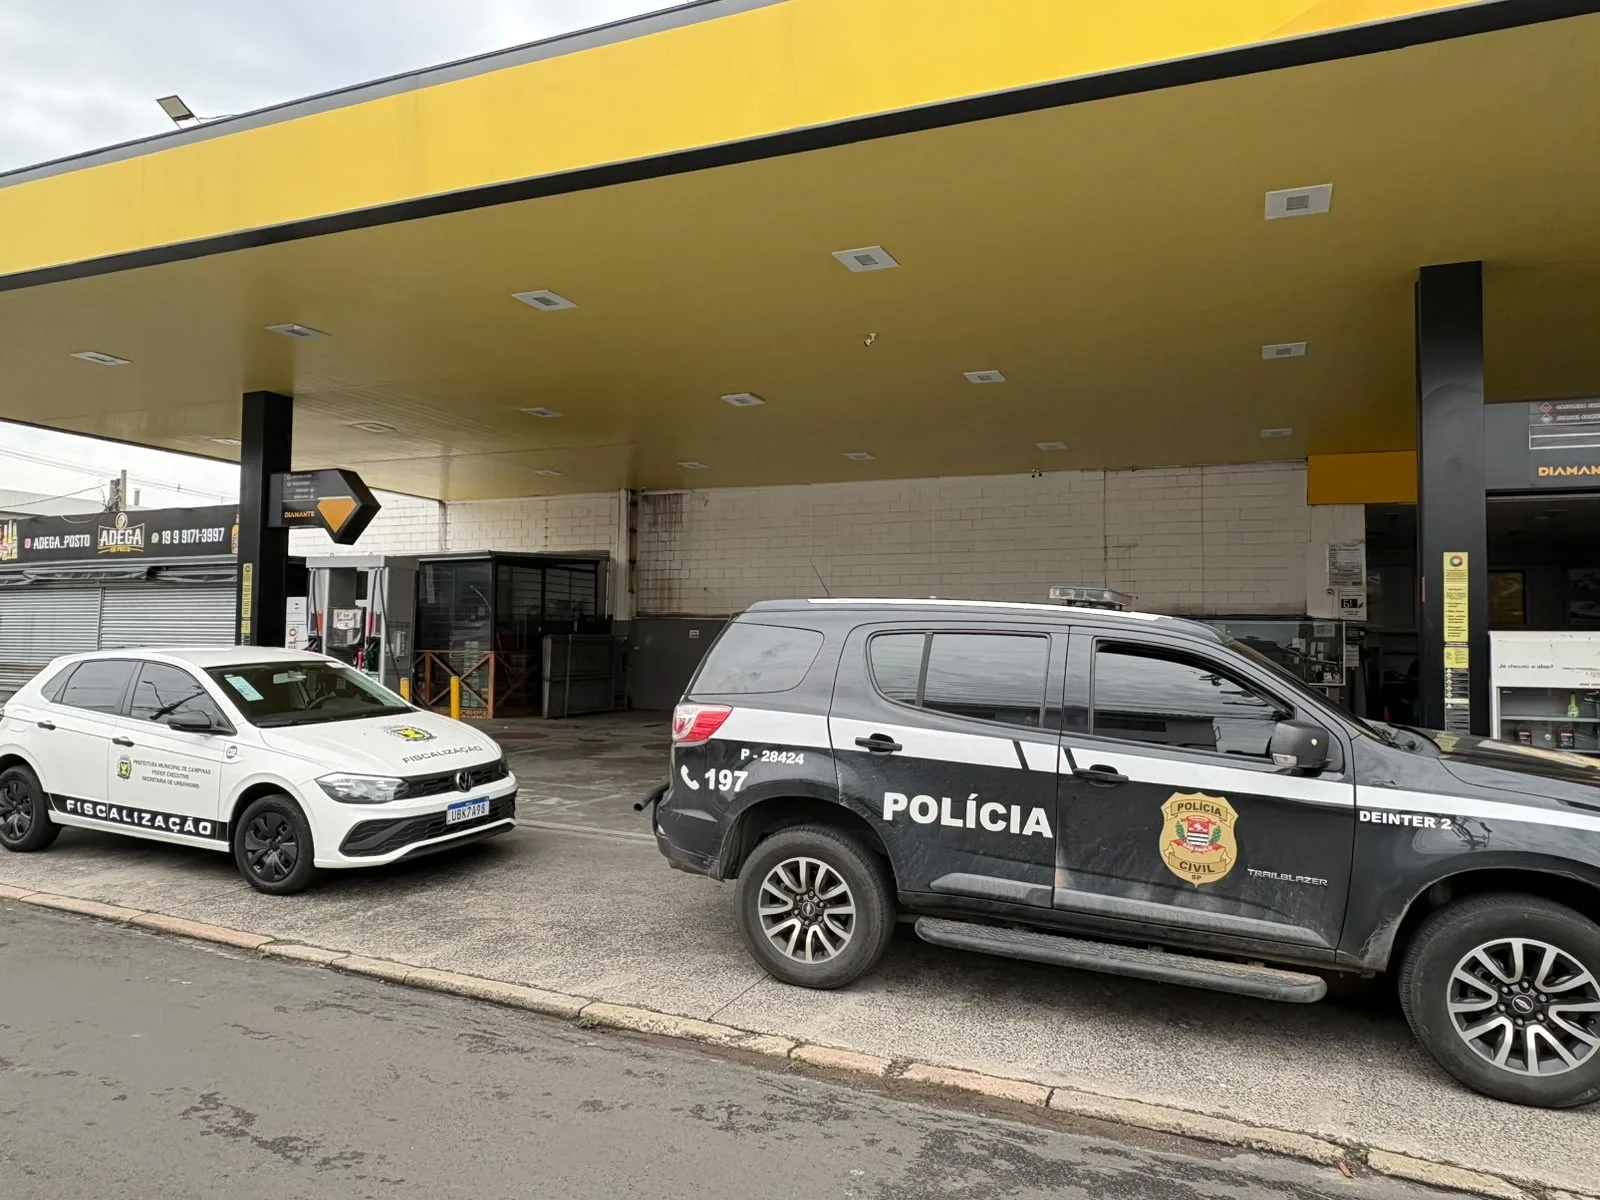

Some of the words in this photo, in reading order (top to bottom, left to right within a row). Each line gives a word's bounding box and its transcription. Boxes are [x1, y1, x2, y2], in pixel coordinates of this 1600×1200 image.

[33, 534, 90, 550] ADEGA_POSTO
[100, 528, 142, 547] ADEGA
[162, 530, 171, 544] 19
[173, 529, 179, 544] 9
[181, 527, 225, 544] 9171-3997
[402, 745, 483, 764] FISCALIZAÇÃO
[740, 748, 750, 760] P
[760, 750, 805, 765] 28424
[133, 759, 157, 768] PREFEITURA
[158, 763, 181, 771] MUNICIPAL
[188, 767, 211, 775] CAMPINAS
[141, 776, 166, 784] SECRETARIA
[704, 768, 748, 792] 197
[66, 799, 211, 835] FISCALIZAÇÃO
[882, 792, 1053, 839] POLÍCIA
[1177, 801, 1222, 816] POLÍCIA
[1359, 810, 1436, 829] DEINTER
[1440, 818, 1452, 830] 2
[1179, 861, 1215, 873] CIVIL
[1247, 868, 1328, 886] TRAILBLAZER
